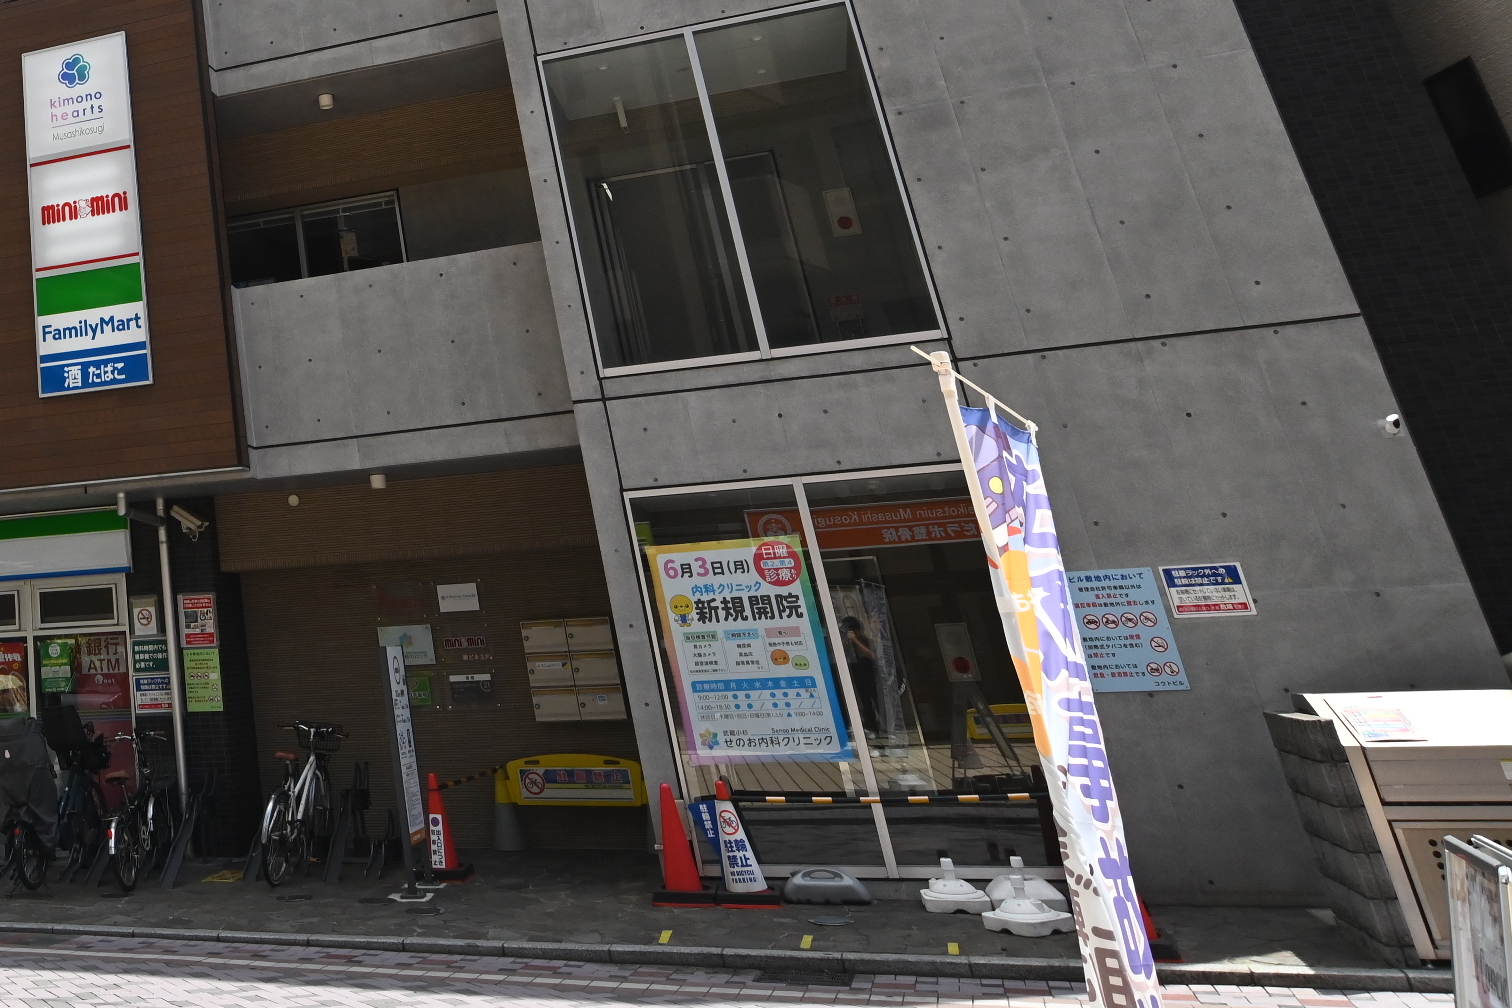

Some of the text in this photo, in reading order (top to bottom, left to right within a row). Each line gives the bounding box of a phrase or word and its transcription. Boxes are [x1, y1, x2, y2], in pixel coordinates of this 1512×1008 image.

[49, 91, 102, 109] kimono
[50, 103, 104, 123] hearts
[52, 123, 105, 142] Musashikosugi
[41, 312, 141, 342] FamilyMart
[64, 362, 126, 388] 酒 たばこ
[761, 544, 789, 559] 日曜
[663, 556, 750, 580] 6月3日(月)
[1171, 568, 1226, 577] 駐輪ラック外への
[691, 581, 762, 597] 内科クリニック
[1174, 576, 1223, 585] 駐輪は禁止です
[694, 592, 804, 625] 新規開院
[86, 637, 120, 656] 銀行
[88, 657, 121, 672] ATM
[723, 735, 833, 748] せのお内科クリニック
[699, 803, 716, 838] 駐輪禁止
[723, 838, 748, 853] 駐輪
[727, 854, 753, 869] 禁止
